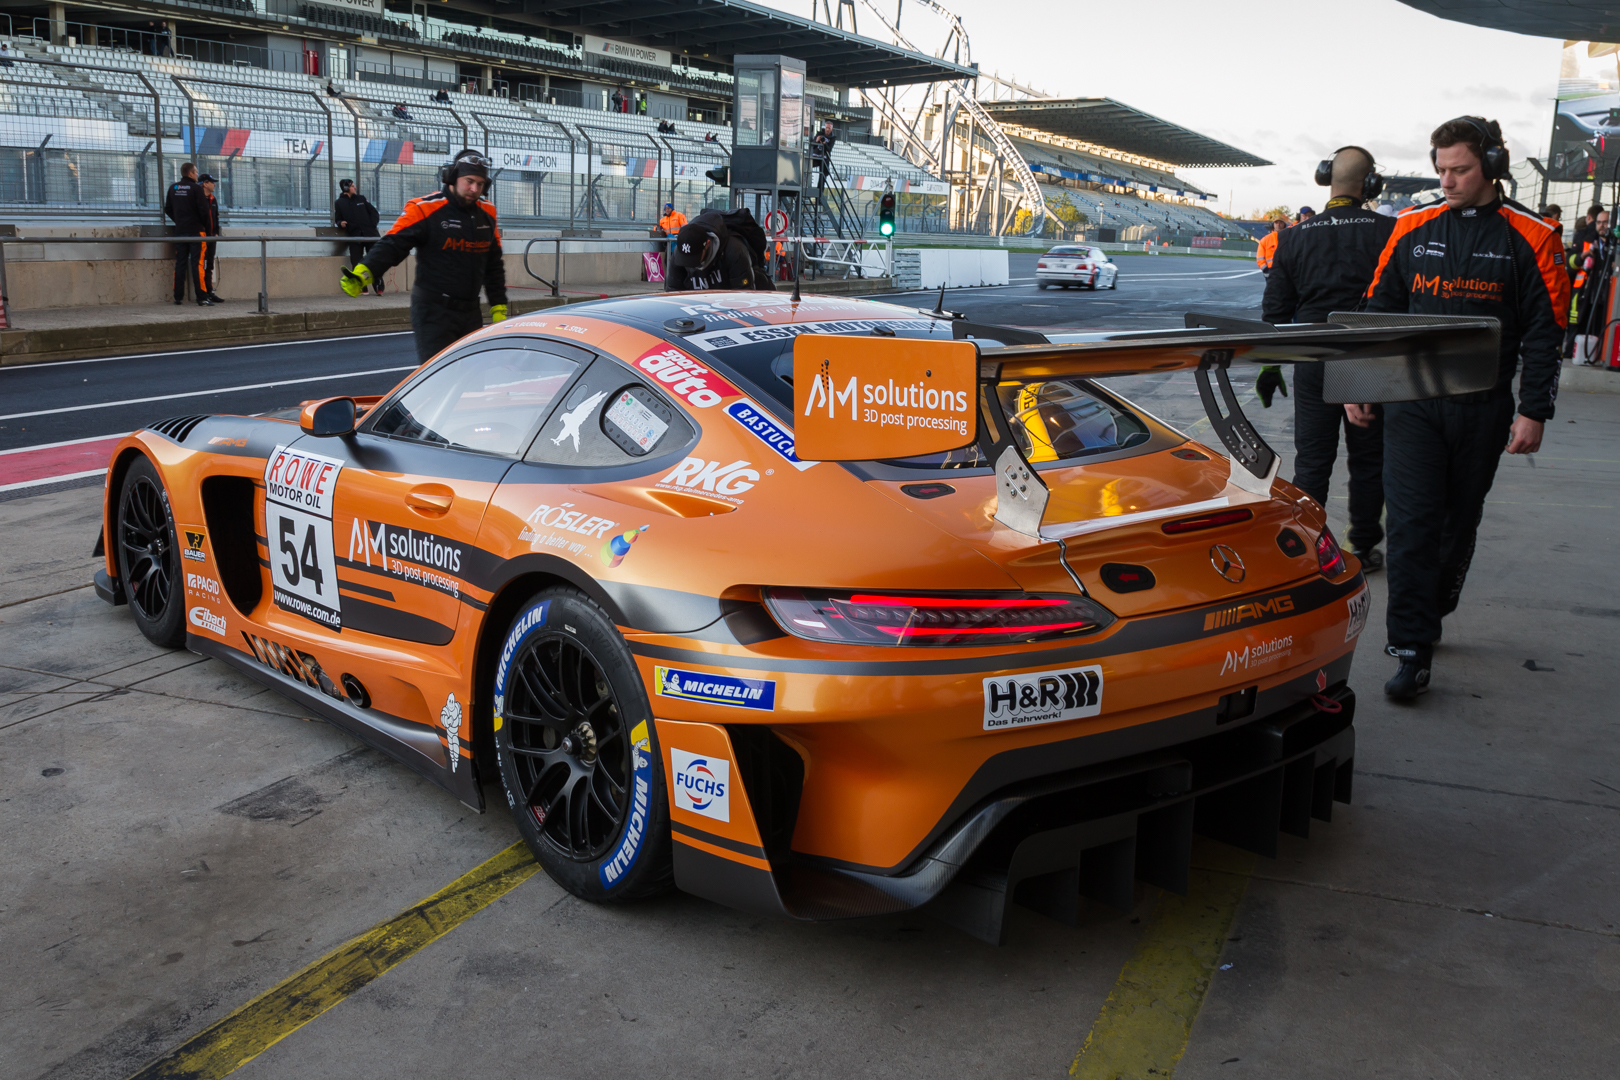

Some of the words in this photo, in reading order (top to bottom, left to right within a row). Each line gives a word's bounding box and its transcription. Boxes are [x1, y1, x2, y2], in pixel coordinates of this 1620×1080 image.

[340, 0, 374, 8] OWER
[615, 44, 629, 57] BMW
[630, 47, 636, 58] M
[636, 48, 657, 62] POWER
[1301, 220, 1330, 230] BLACK
[1338, 217, 1375, 225] FALCON
[442, 237, 465, 251] AM
[1411, 272, 1440, 296] AM
[1442, 276, 1504, 292] solutions
[702, 308, 764, 323] finding
[661, 349, 708, 376] sport
[639, 354, 722, 408] auto
[804, 373, 858, 421] AM
[863, 378, 967, 412] solutions
[863, 408, 878, 423] 3D
[881, 412, 904, 427] post
[907, 414, 967, 435] processing
[219, 437, 249, 447] AMG
[269, 454, 333, 495] ROWE
[660, 456, 760, 495] RKG
[269, 482, 302, 504] MOTOR
[305, 494, 321, 509] OIL
[526, 502, 616, 539] RÖSLER
[184, 548, 206, 559] BAUER
[278, 515, 324, 597] 54
[348, 517, 388, 572] AM
[389, 528, 461, 573] solutions
[544, 532, 568, 549] better
[567, 541, 586, 556] way
[197, 575, 220, 595] PAGID
[391, 559, 403, 576] 3D
[404, 564, 422, 581] post
[422, 570, 460, 598] processing
[189, 589, 221, 604] RACING
[273, 589, 341, 626] www.rowe.com.de
[1236, 594, 1296, 624] AMG
[189, 606, 227, 630] Eibach
[496, 606, 543, 691] MICHELIN
[1220, 645, 1249, 676] AM
[1251, 635, 1293, 658] solutions
[683, 679, 763, 700] MICHELIN
[989, 677, 1061, 714] H&R
[987, 719, 1008, 727] Das
[1011, 711, 1062, 724] Fahrwerk!
[676, 772, 725, 797] FUCHS
[604, 775, 648, 883] MICHELIN
